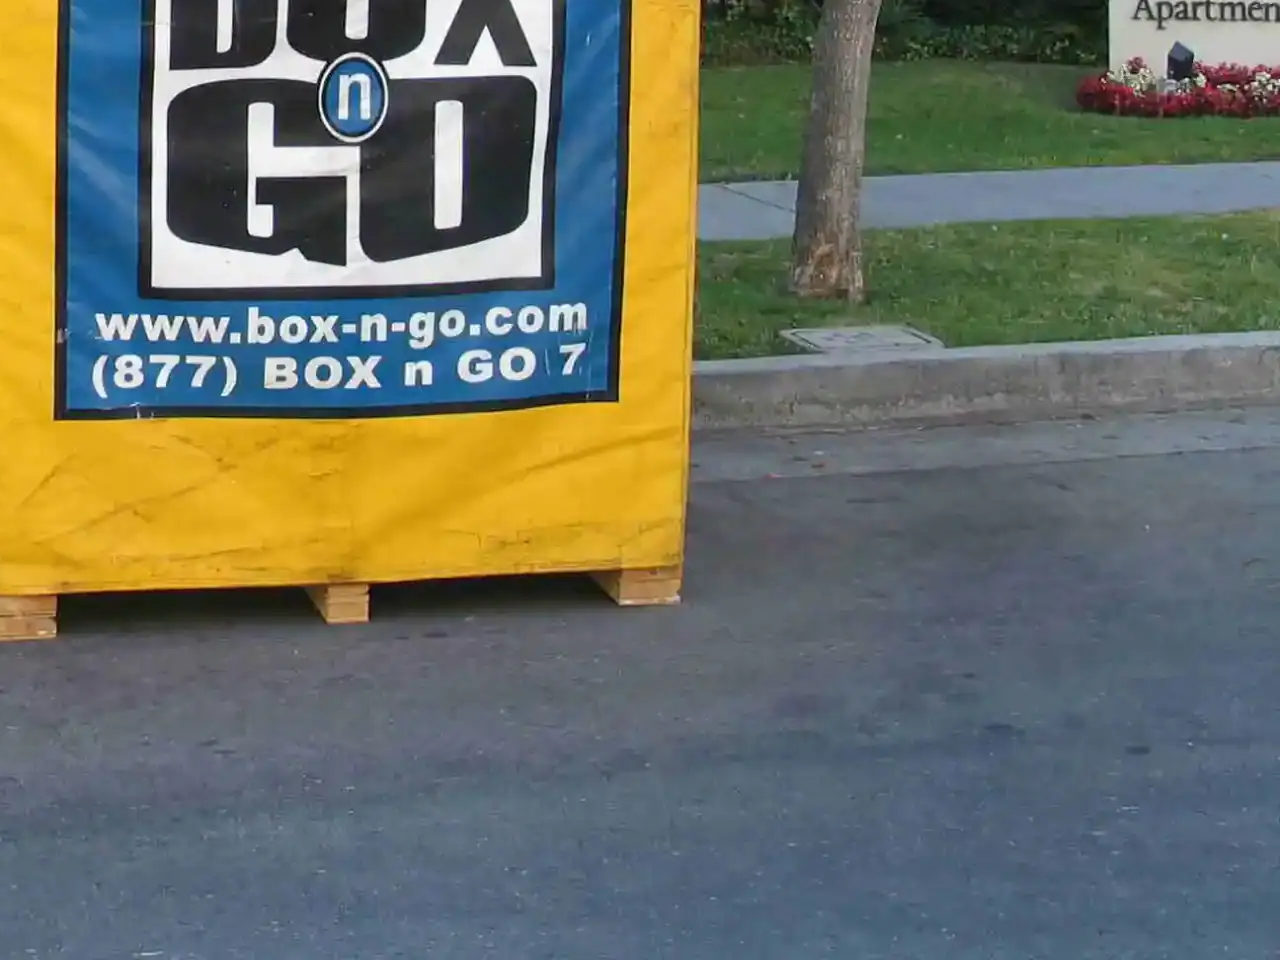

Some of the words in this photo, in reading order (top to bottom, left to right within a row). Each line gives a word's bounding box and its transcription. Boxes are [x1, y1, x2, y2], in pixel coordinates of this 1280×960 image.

[337, 69, 372, 121] n
[166, 74, 538, 267] GO
[94, 299, 588, 349] www.box-n-go.com
[92, 354, 237, 399] (877)
[264, 354, 381, 390] BOX
[404, 359, 433, 386] n
[457, 347, 536, 383] GO
[559, 343, 586, 376] 7
